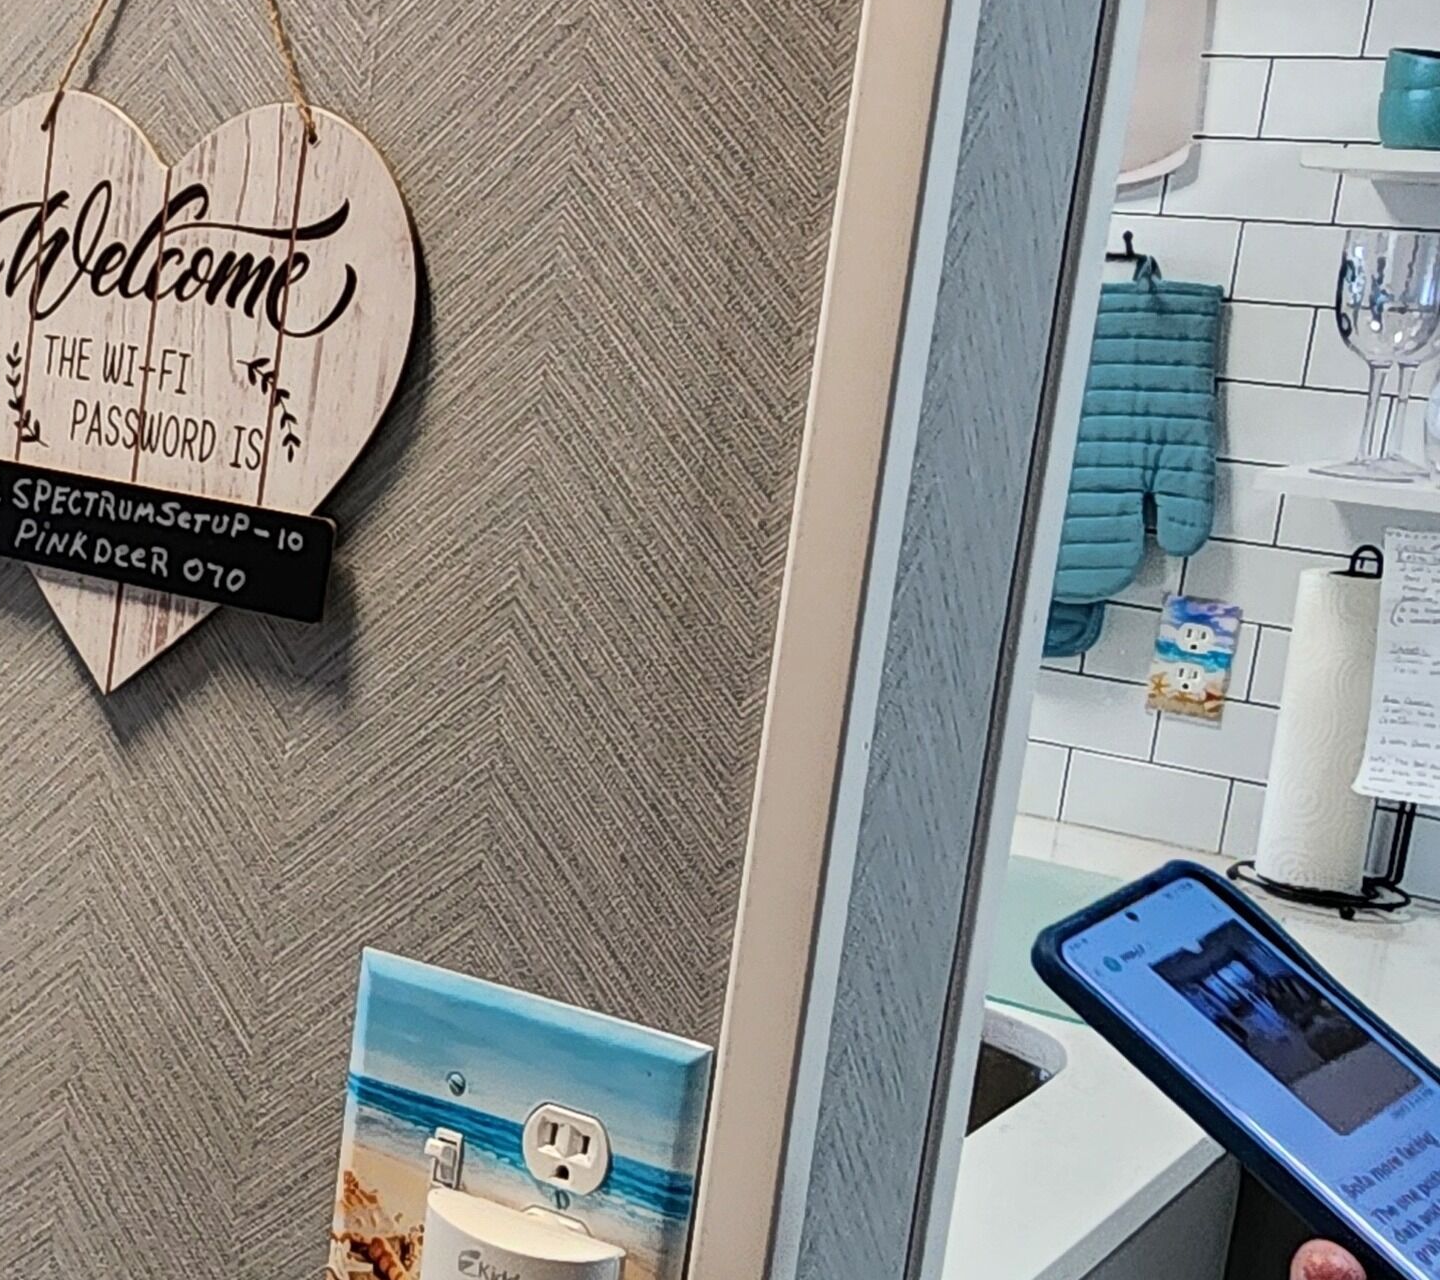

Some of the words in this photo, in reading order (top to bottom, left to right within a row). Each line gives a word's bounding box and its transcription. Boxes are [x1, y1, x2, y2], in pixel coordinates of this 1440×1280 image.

[44, 334, 93, 381] THE
[102, 341, 192, 395] WI-FI
[70, 399, 216, 463] PASSWORD
[229, 424, 264, 471] IS
